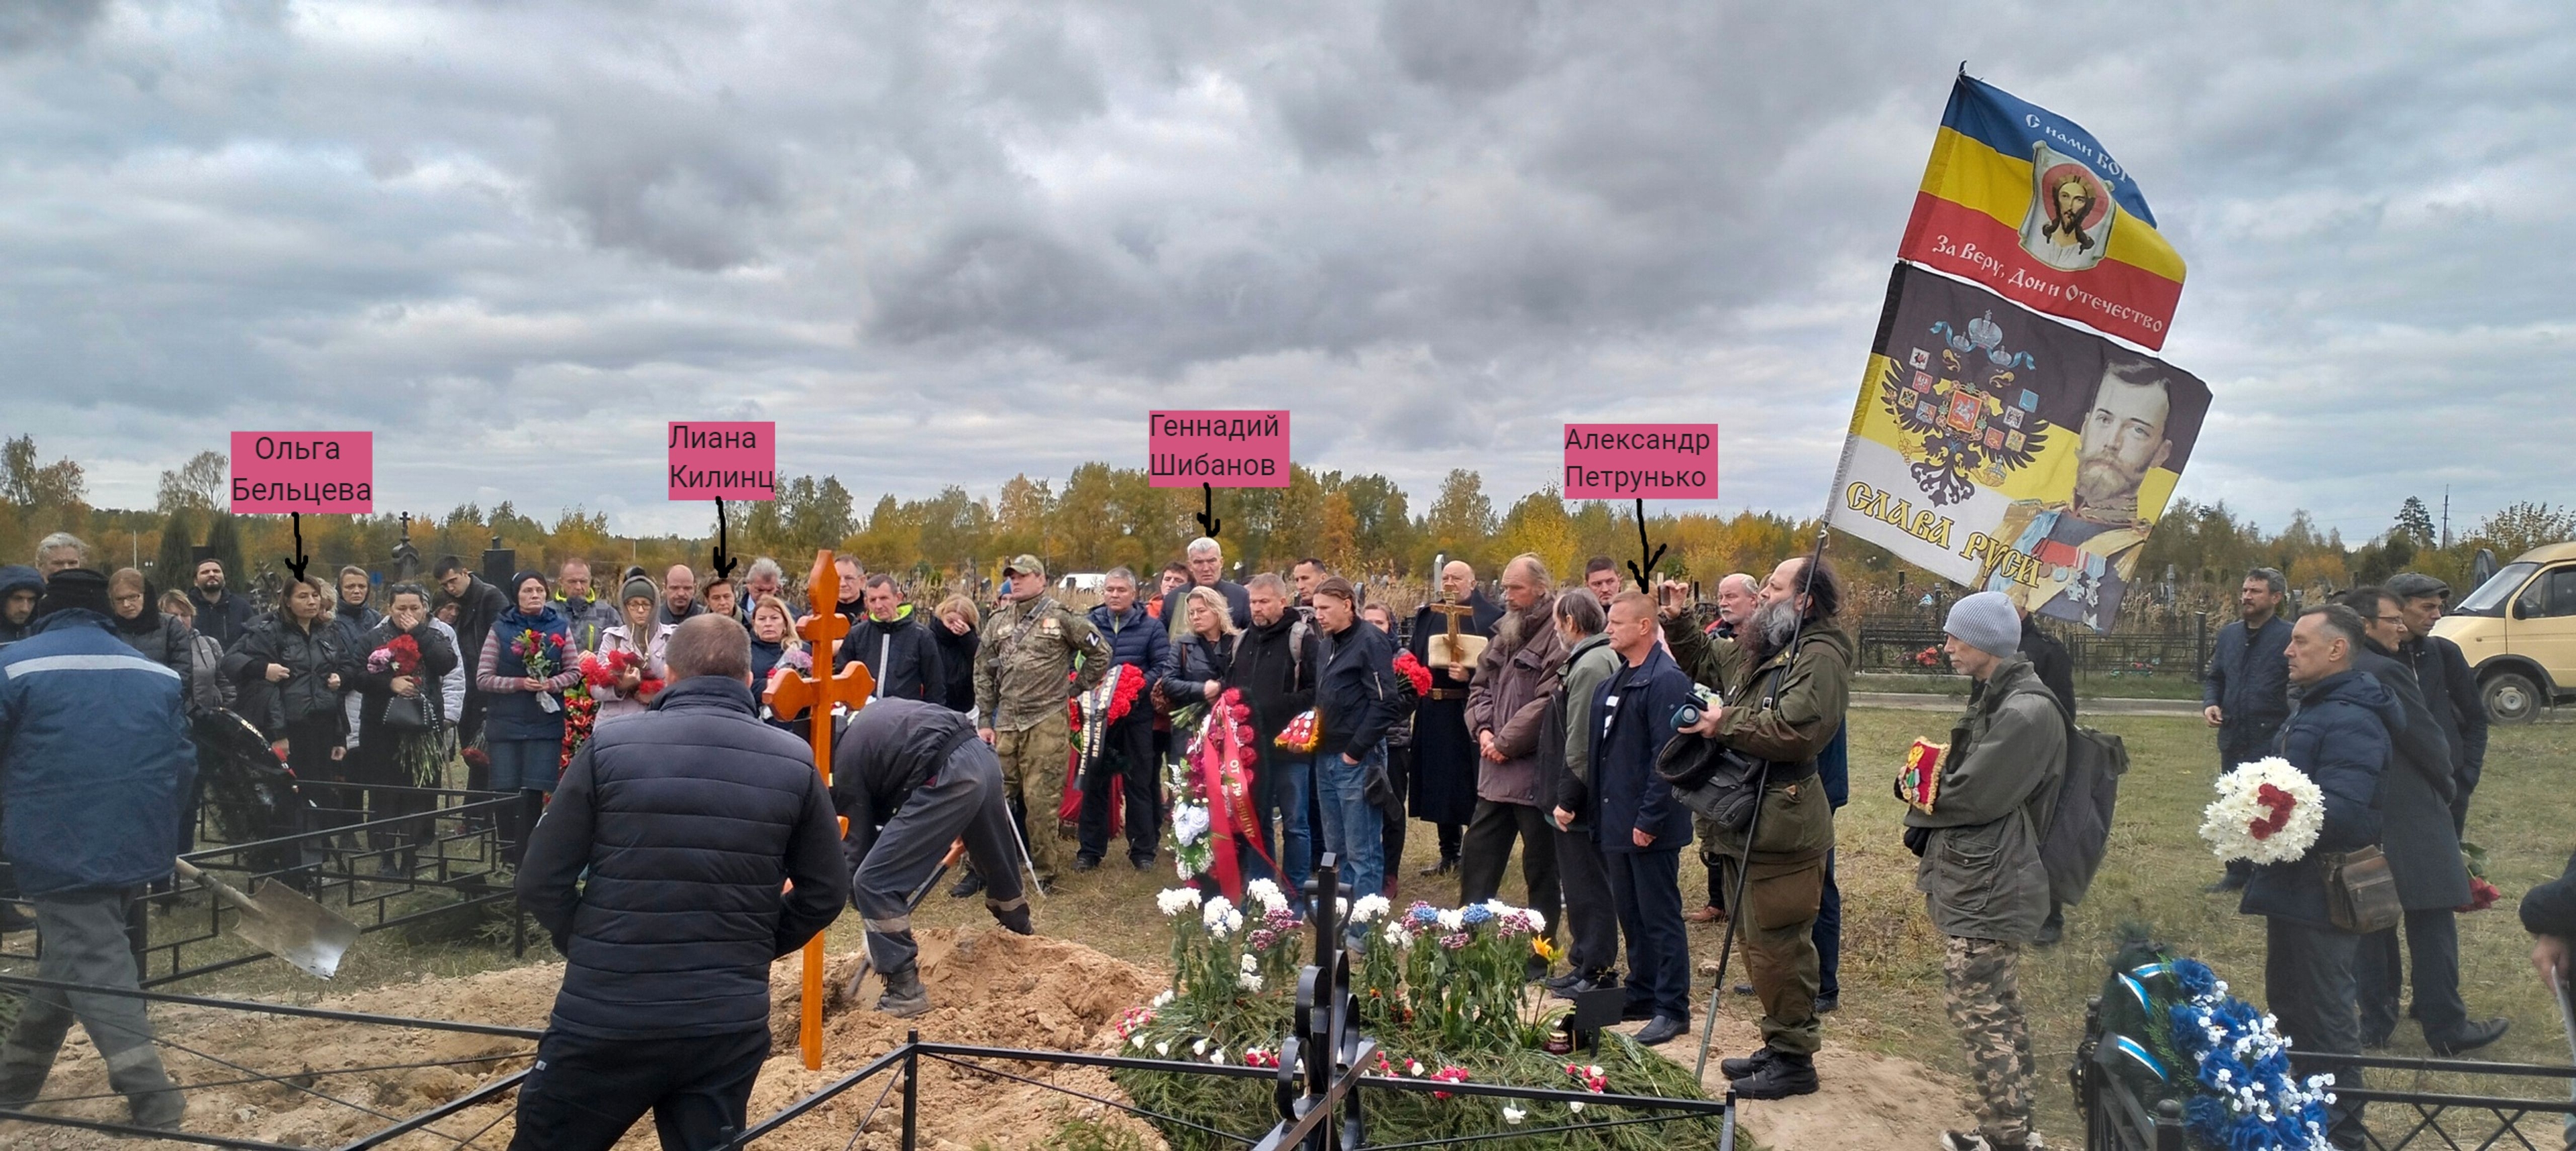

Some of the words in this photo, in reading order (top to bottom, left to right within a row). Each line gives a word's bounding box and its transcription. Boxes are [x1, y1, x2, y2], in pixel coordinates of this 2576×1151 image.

[2025, 114, 2041, 128] С
[2045, 126, 2093, 158] нами
[1932, 234, 1956, 256] За
[1959, 243, 2005, 278] Веру,
[2008, 268, 2046, 292] Дон
[1846, 482, 1954, 550] СЛАВА
[1959, 531, 2043, 588] РУСИ
